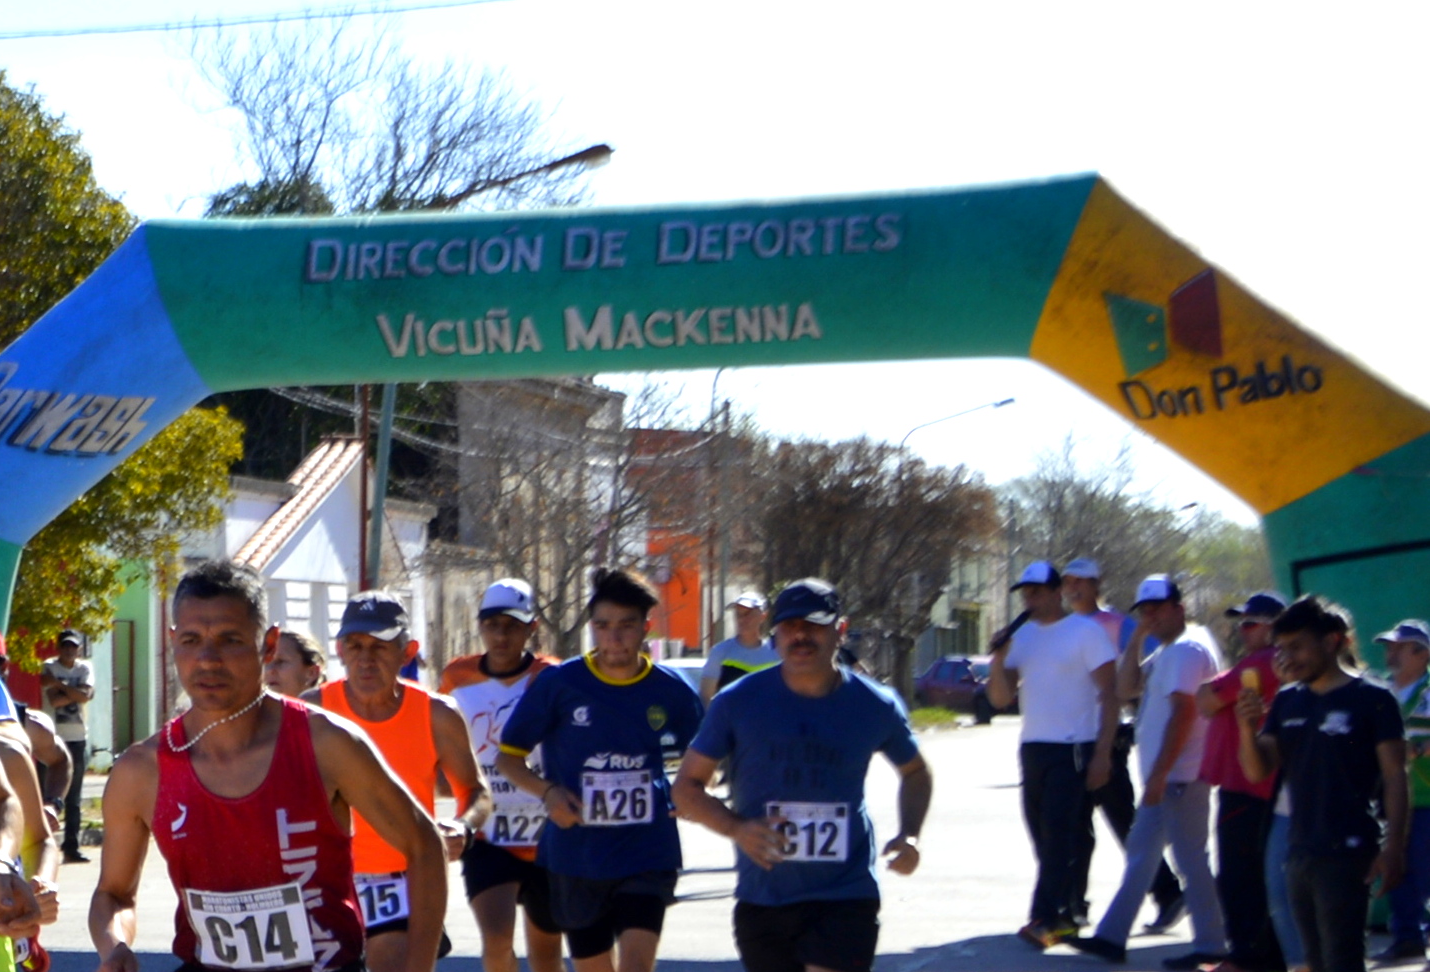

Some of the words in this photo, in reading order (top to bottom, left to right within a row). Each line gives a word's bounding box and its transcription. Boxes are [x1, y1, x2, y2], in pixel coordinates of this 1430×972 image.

[1118, 379, 1205, 420] Don
[1210, 354, 1325, 412] Pablo
[590, 787, 648, 821] A26
[776, 820, 839, 858] C12
[204, 910, 299, 964] C14
